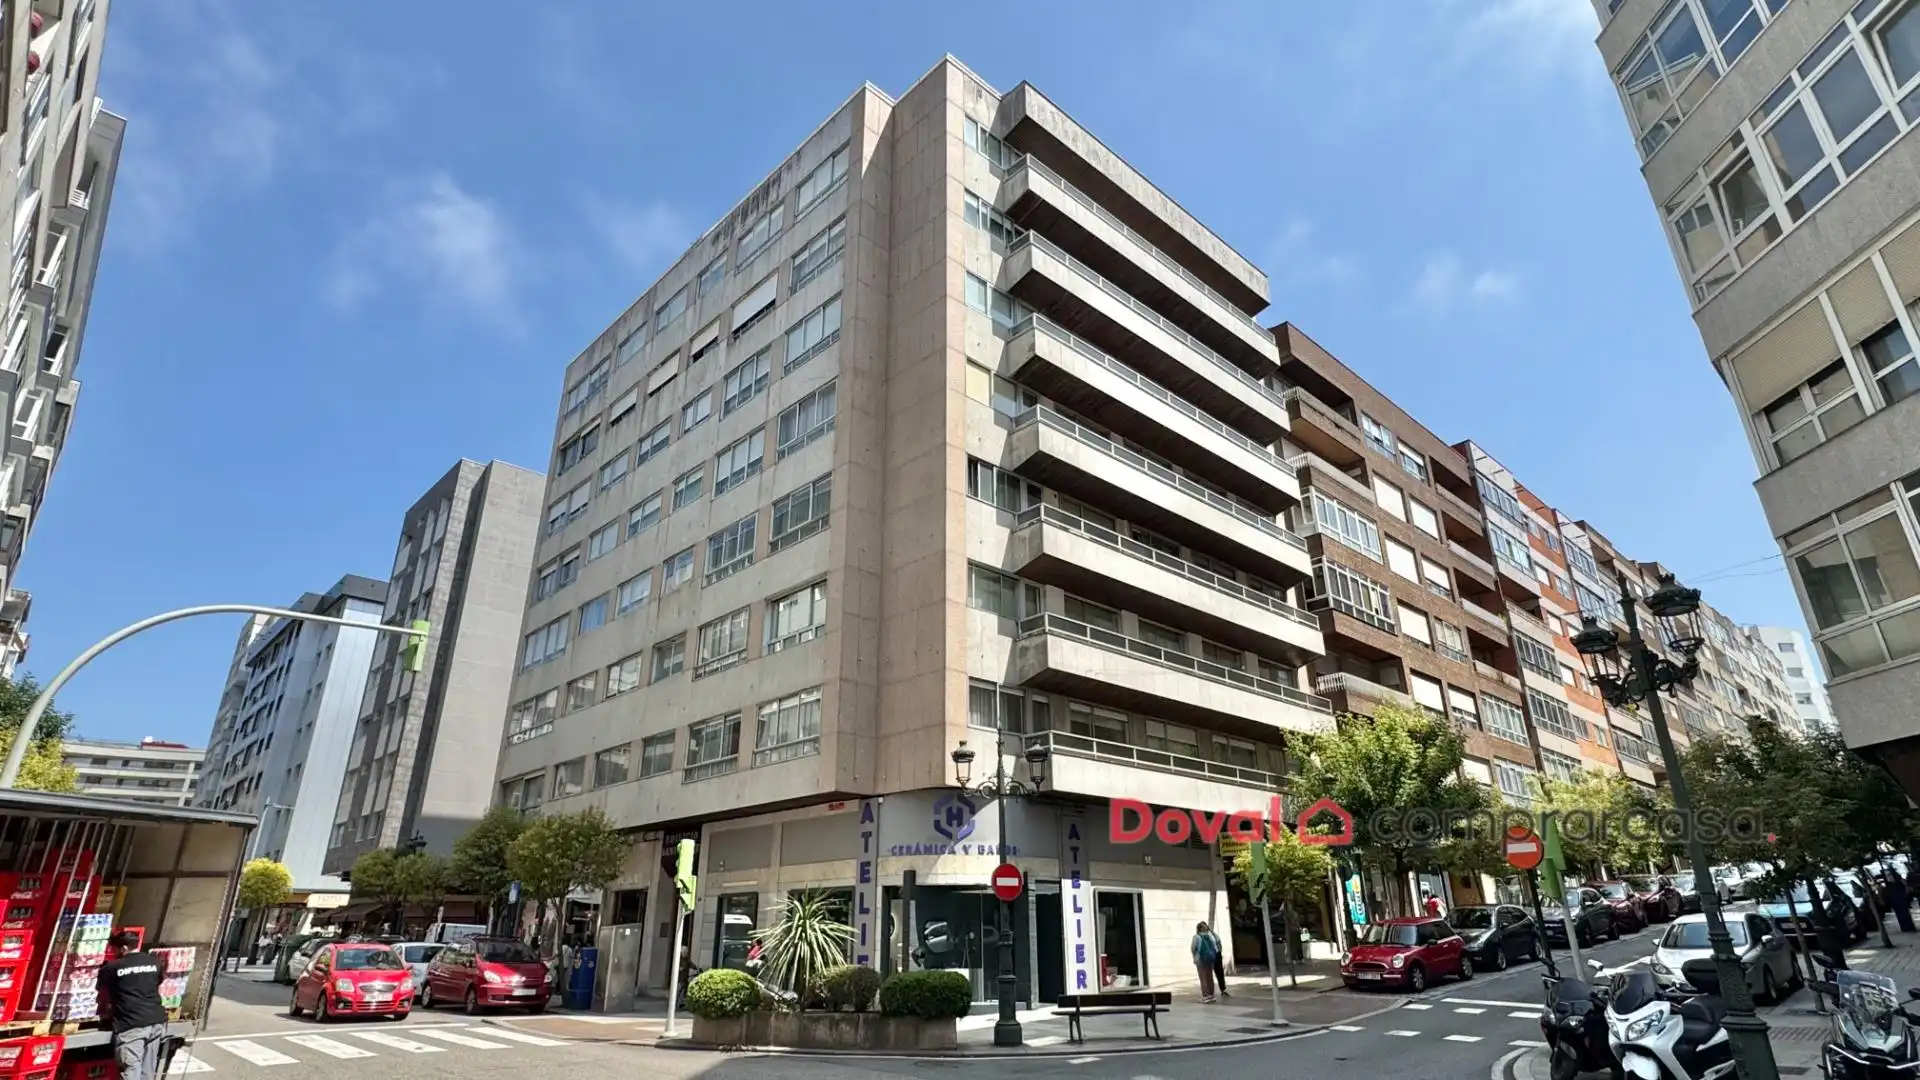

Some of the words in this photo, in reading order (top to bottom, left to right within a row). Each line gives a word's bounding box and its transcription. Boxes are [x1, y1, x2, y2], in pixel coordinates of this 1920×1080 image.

[857, 801, 875, 965] ATELI
[891, 842, 957, 857] CERÁMICA
[962, 844, 972, 856] Y
[1068, 823, 1088, 989] ATELIER
